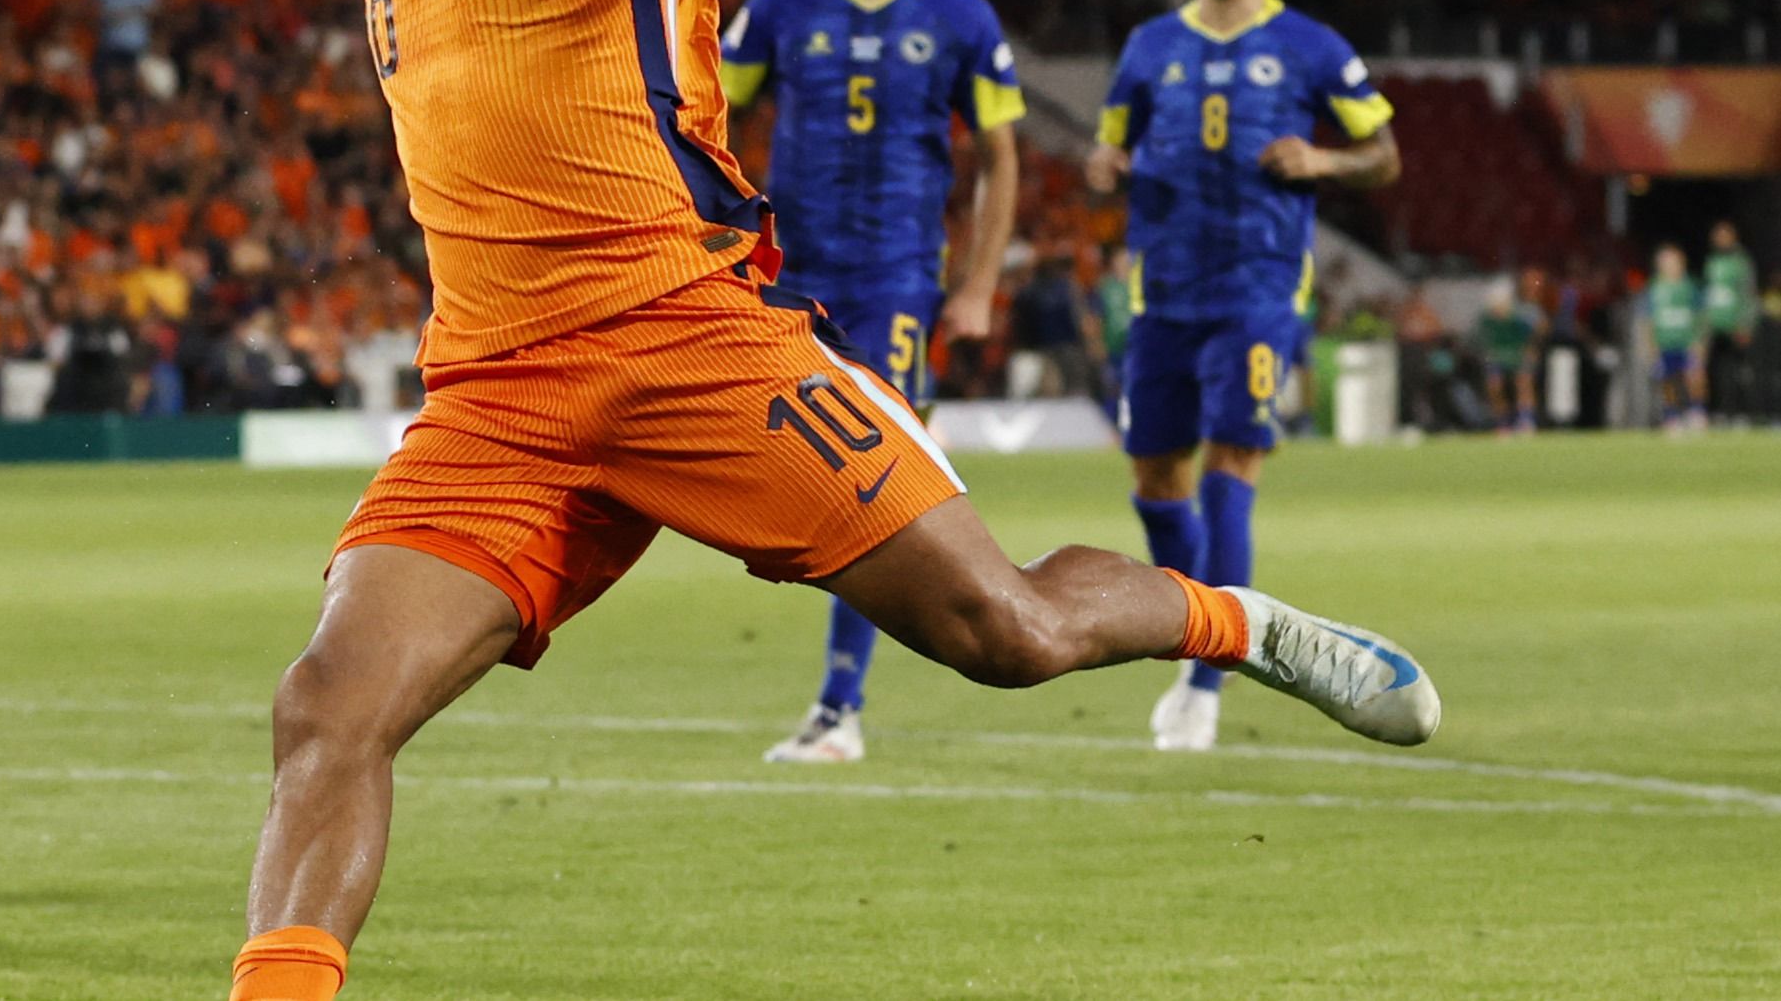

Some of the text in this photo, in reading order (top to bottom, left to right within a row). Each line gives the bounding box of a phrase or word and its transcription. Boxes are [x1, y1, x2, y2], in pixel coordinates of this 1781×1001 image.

[847, 74, 876, 134] 5
[1202, 93, 1228, 151] 8
[888, 312, 919, 373] 5
[1247, 343, 1275, 401] 8
[767, 373, 883, 473] 10
